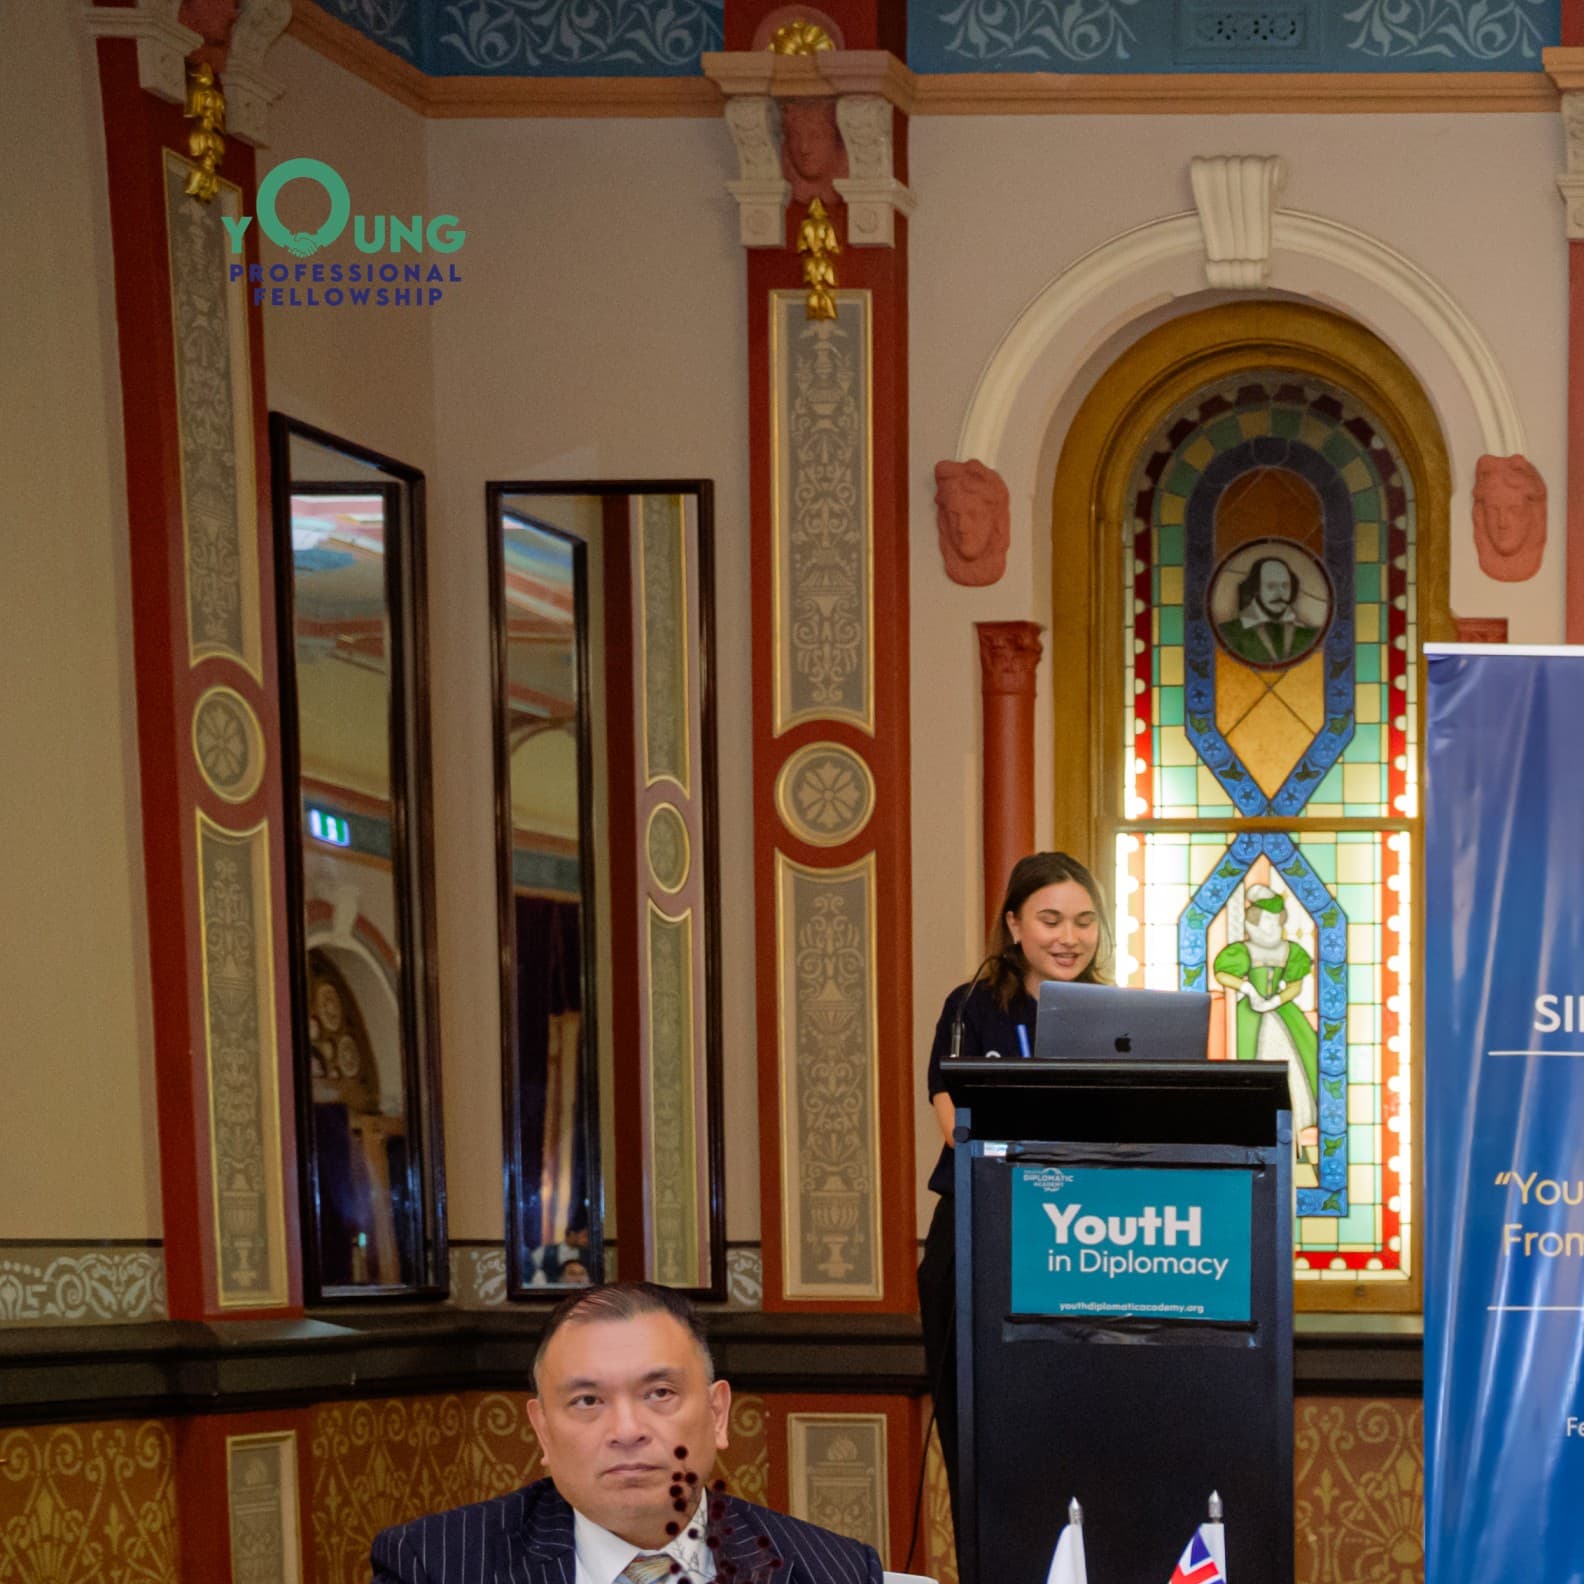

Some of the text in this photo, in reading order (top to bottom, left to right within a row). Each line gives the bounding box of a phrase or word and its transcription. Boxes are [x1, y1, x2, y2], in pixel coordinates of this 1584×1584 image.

[1042, 1203, 1202, 1246] YoutH
[1048, 1249, 1229, 1281] in Diplomacy
[1059, 1302, 1205, 1314] youthdiplomaticacademy.org
